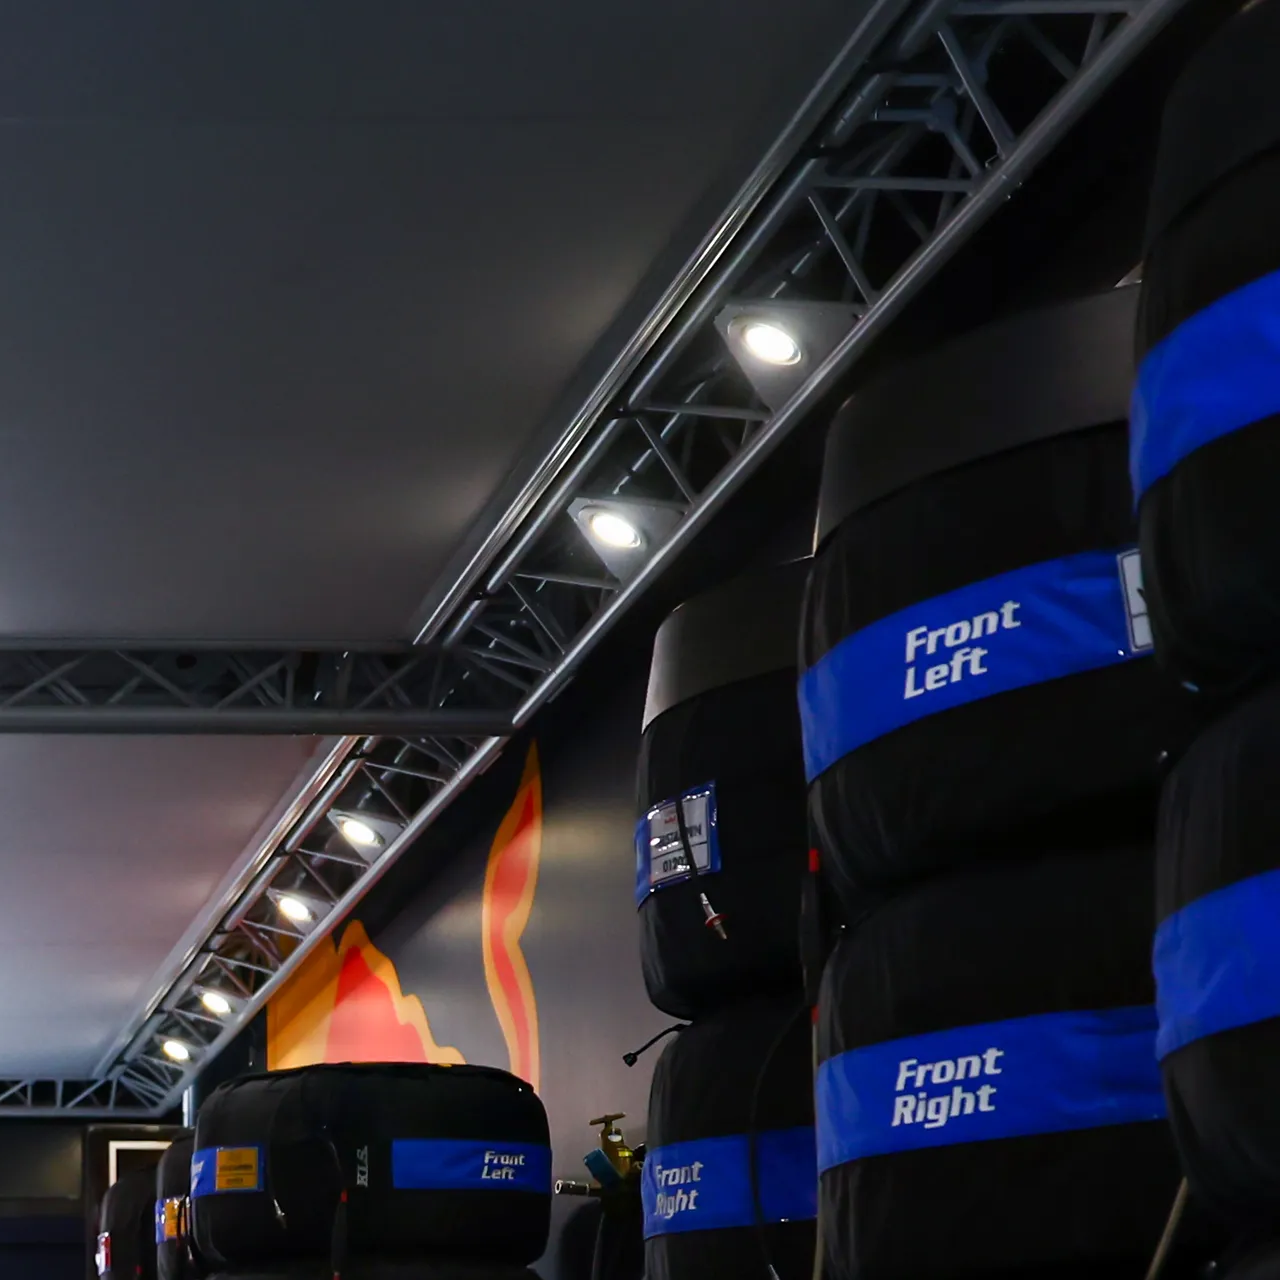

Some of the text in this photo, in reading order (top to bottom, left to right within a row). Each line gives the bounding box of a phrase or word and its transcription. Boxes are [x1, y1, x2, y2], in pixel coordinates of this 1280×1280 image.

[904, 600, 1022, 664] Front
[903, 646, 989, 700] Left
[894, 1047, 1005, 1092] Front
[891, 1084, 997, 1129] Right
[481, 1166, 516, 1180] Left
[484, 1150, 525, 1166] Front
[655, 1161, 704, 1188] Front
[654, 1189, 699, 1220] Right
